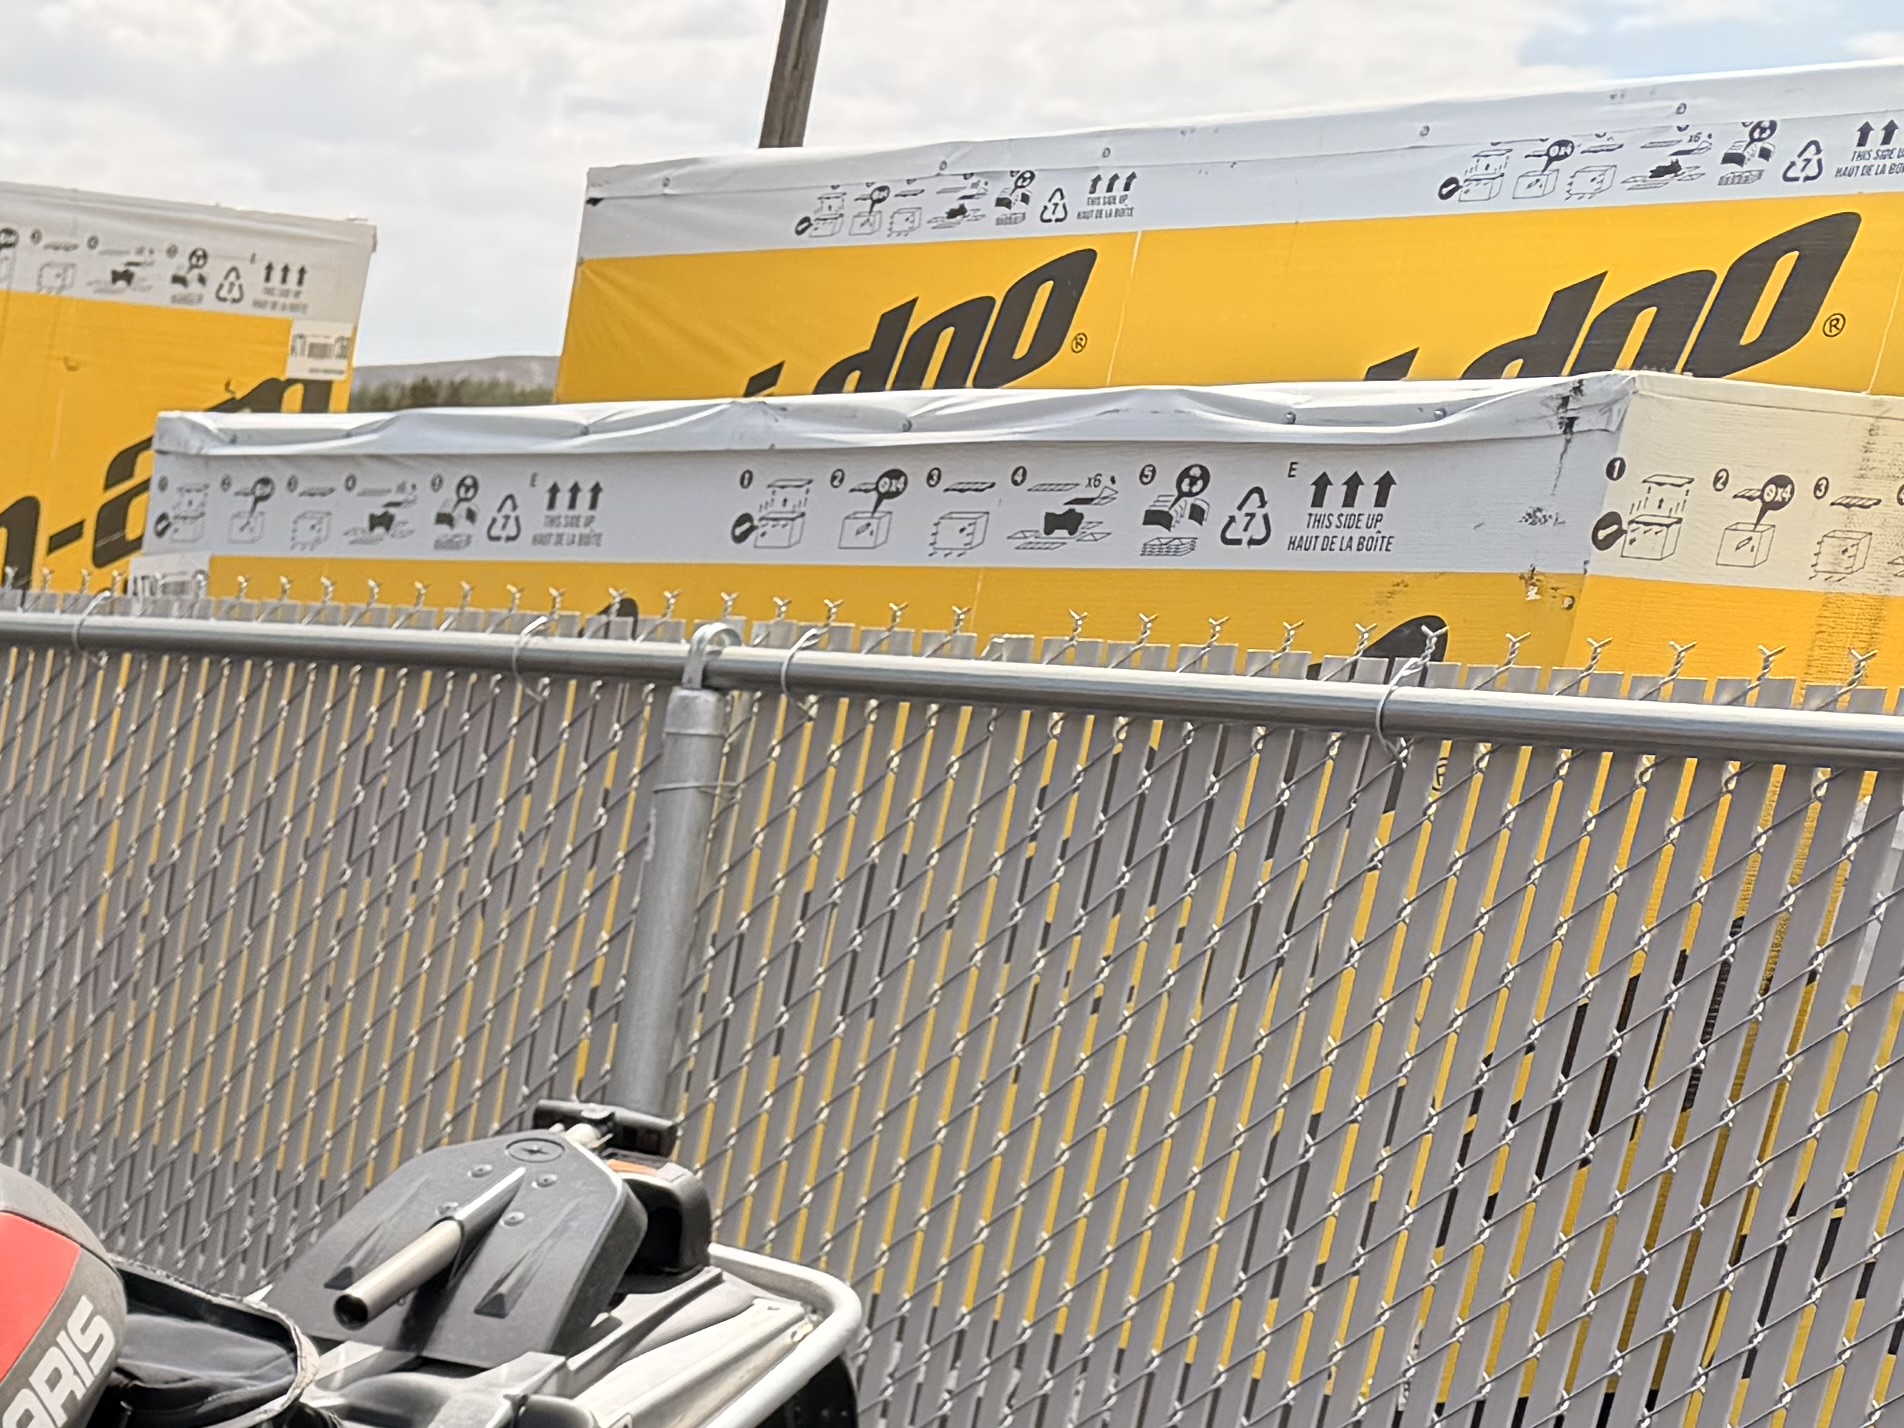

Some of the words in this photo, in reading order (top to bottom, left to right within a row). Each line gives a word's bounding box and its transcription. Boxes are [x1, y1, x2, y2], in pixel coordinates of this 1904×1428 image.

[1288, 462, 1298, 478] E
[1306, 513, 1333, 529] THIS
[1336, 513, 1364, 529] SIDE
[1366, 513, 1383, 529] UP
[1287, 535, 1319, 551] HAUT
[1321, 535, 1337, 551] DE
[1339, 535, 1353, 551] LA
[1356, 530, 1395, 552] BOÎTE
